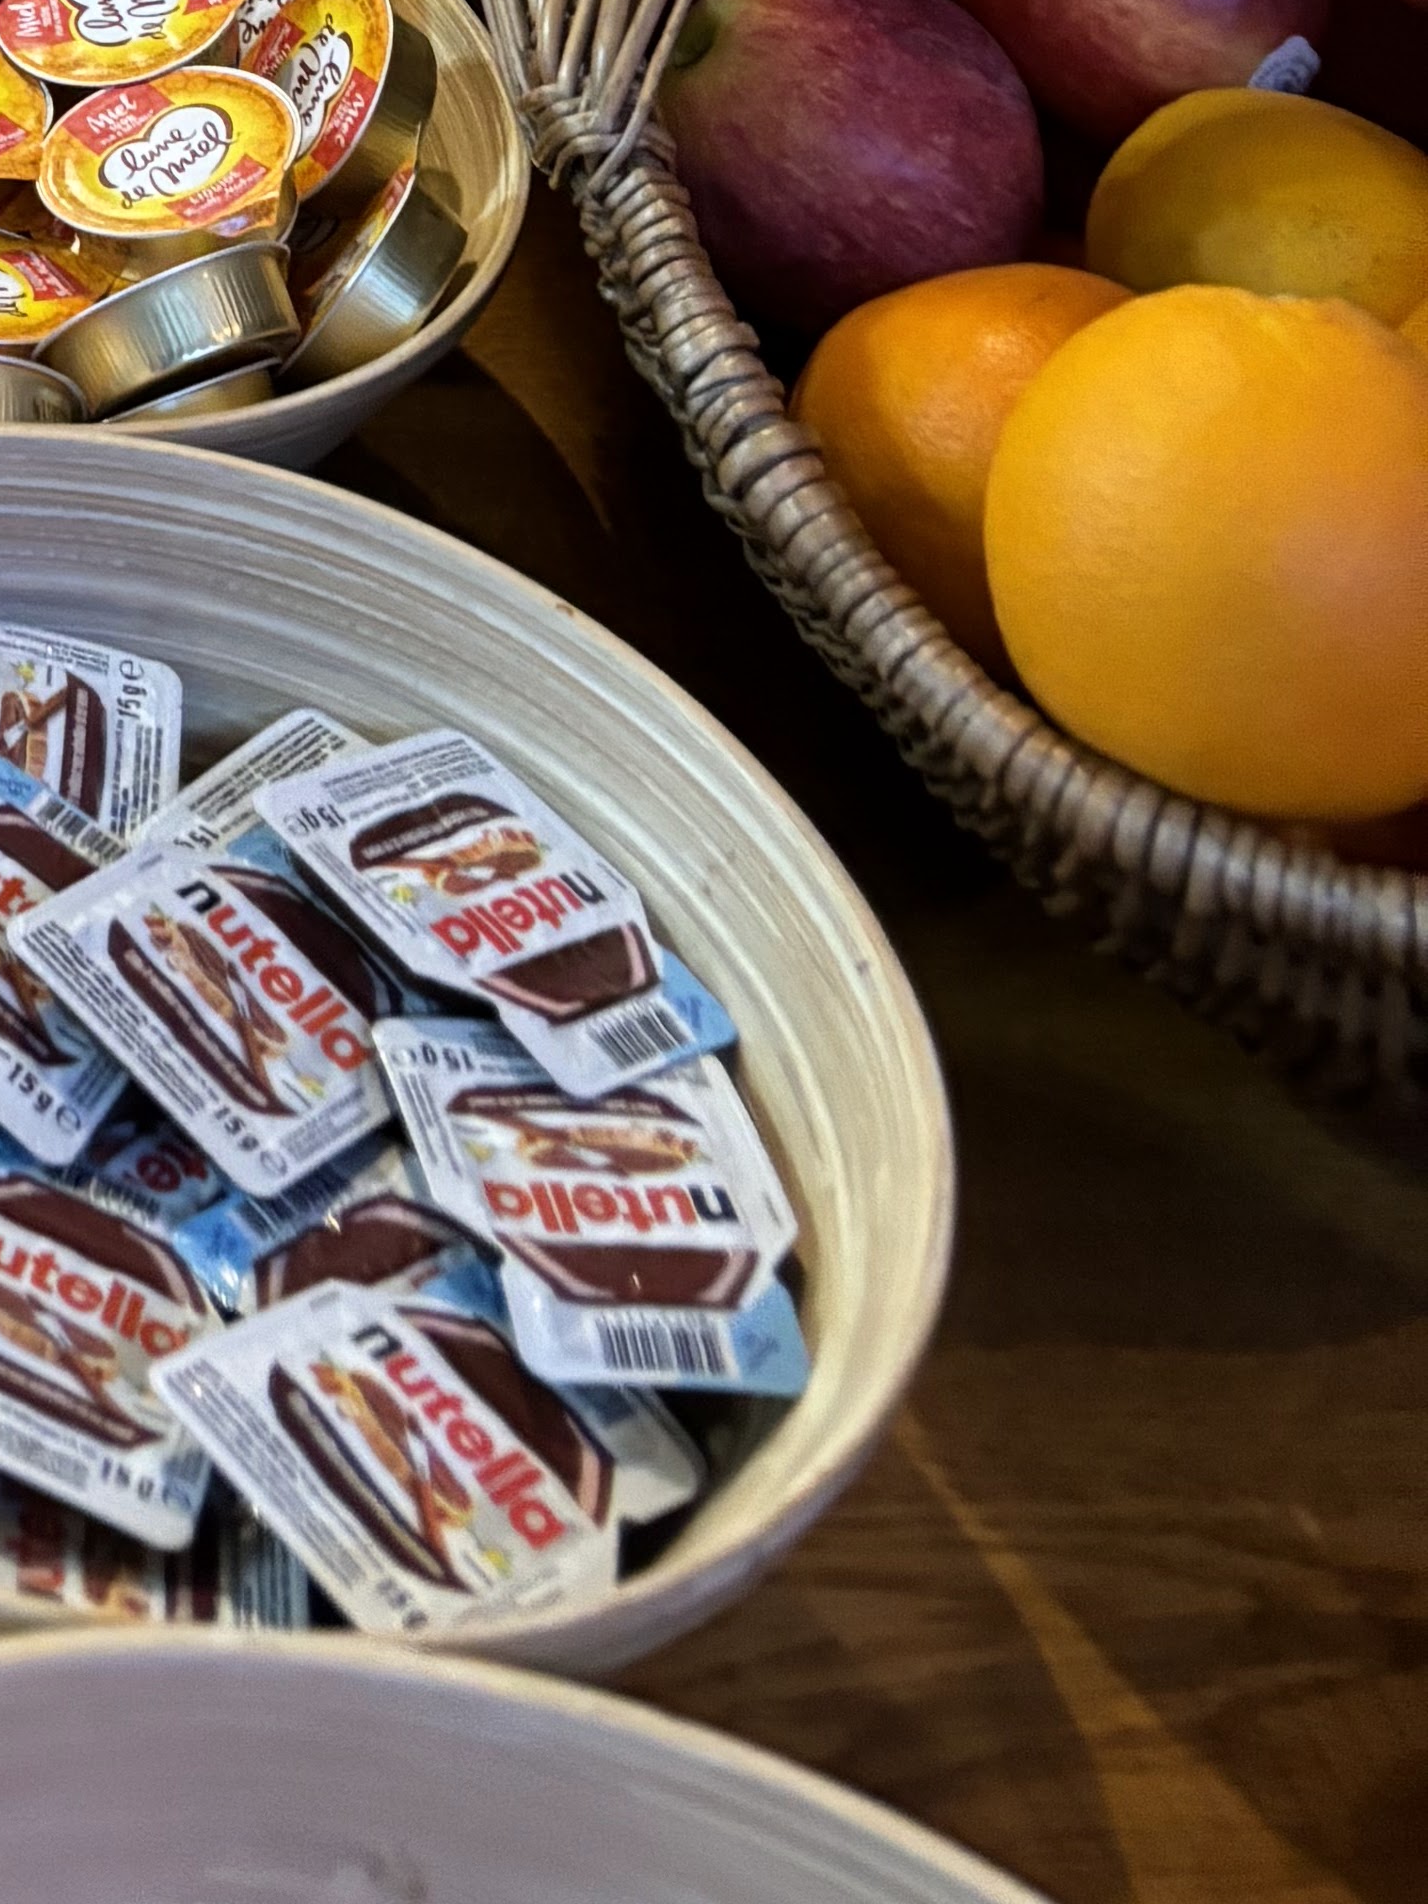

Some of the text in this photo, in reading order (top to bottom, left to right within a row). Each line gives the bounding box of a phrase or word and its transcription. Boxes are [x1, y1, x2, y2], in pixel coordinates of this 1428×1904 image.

[86, 93, 137, 133] Miel
[121, 128, 196, 181] lune
[120, 121, 241, 210] de Miel
[429, 870, 608, 958] nutella
[175, 880, 375, 1073] nutella
[482, 1179, 738, 1235] nutella
[351, 1322, 570, 1551] nutella
